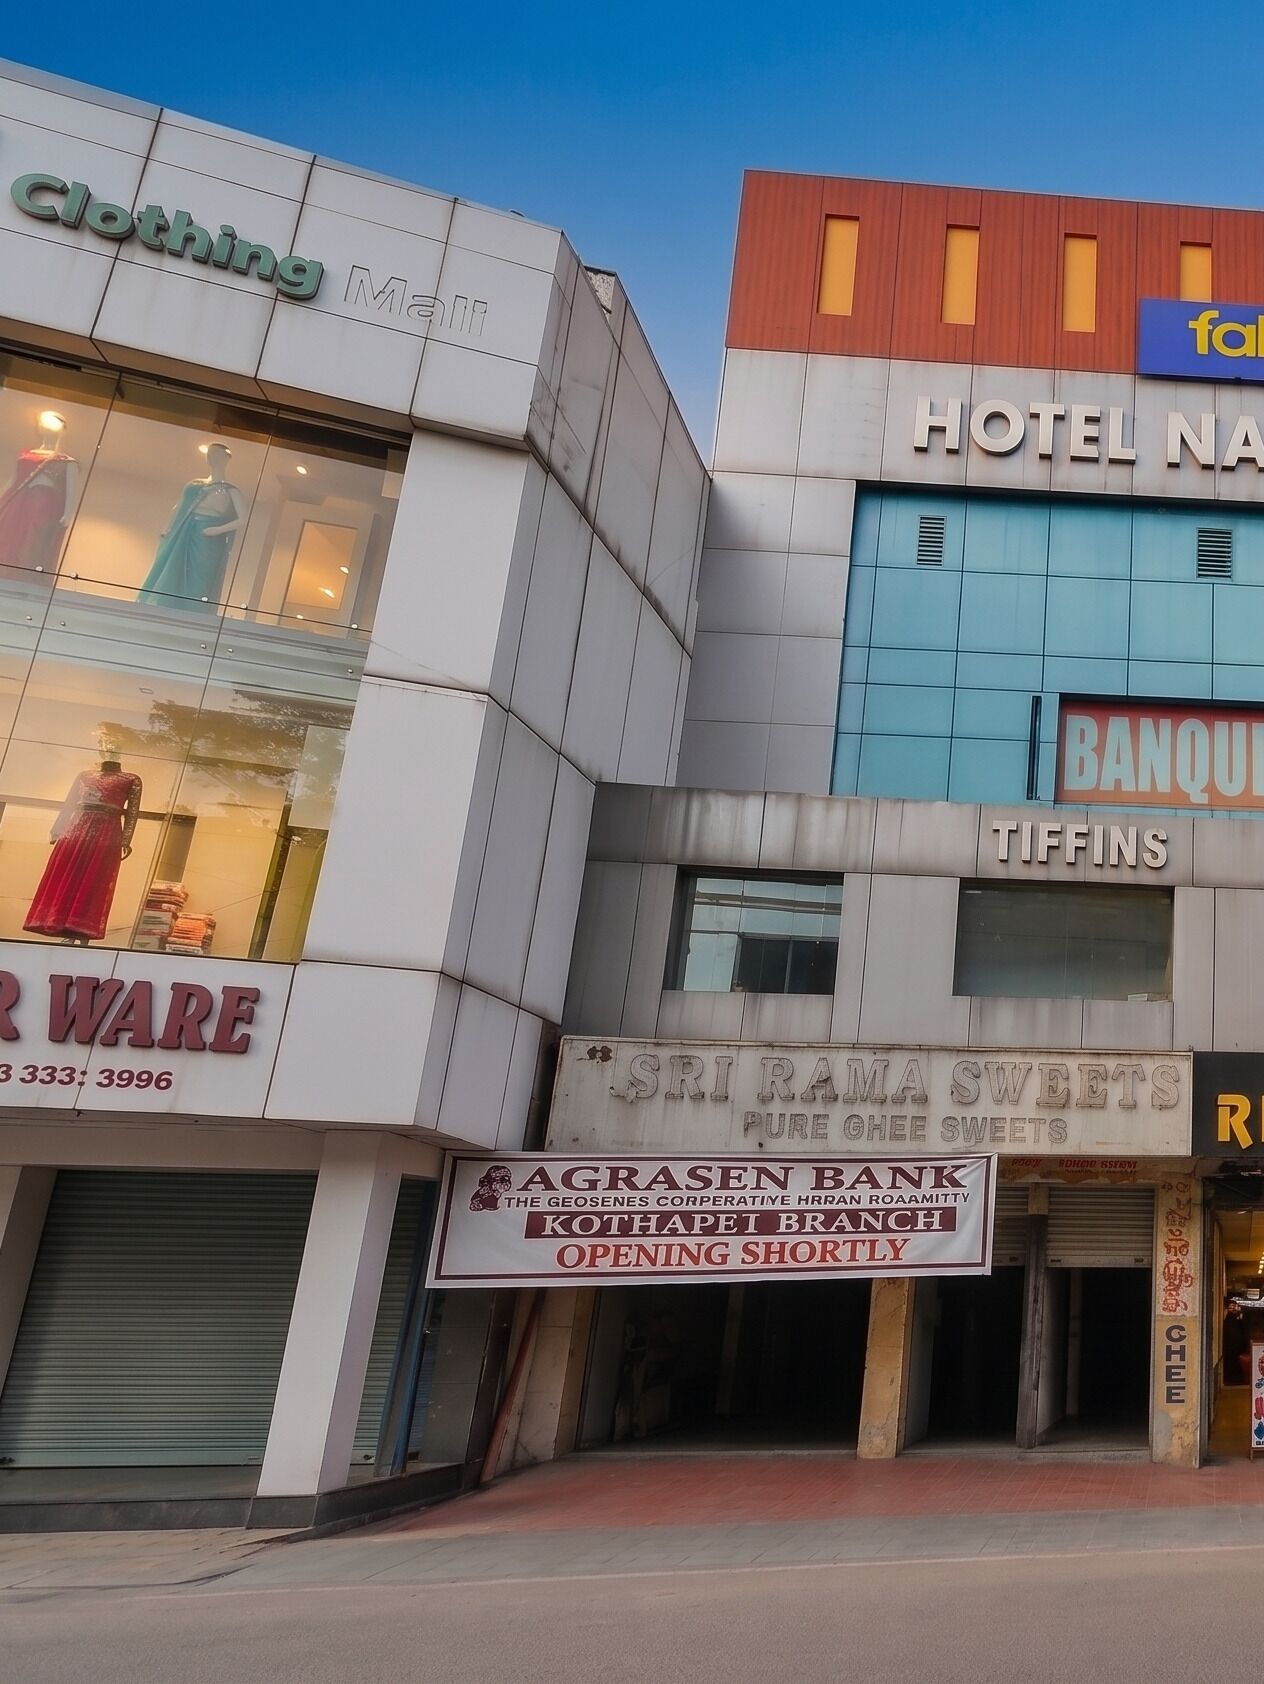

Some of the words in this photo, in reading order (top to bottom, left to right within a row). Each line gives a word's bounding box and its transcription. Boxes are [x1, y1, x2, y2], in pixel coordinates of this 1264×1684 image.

[10, 173, 325, 300] Clothing
[343, 264, 489, 337] Mall
[913, 396, 1136, 464] HOTEL
[992, 820, 1167, 868] TIFFINS
[95, 1068, 174, 1091] 3996
[628, 1053, 735, 1102] SRI
[757, 1055, 928, 1104] RAMA
[950, 1060, 1181, 1109] SWEETS
[743, 1111, 830, 1141] PURE
[843, 1114, 927, 1143] GHEE
[940, 1115, 1068, 1145] SWEETS
[516, 1166, 794, 1192] AGRASEN
[809, 1163, 969, 1191] BANK
[503, 1195, 542, 1209] THE
[546, 1195, 649, 1208] GEOSENES
[775, 1206, 944, 1232] BRANCH
[555, 1241, 730, 1270] OPENING
[740, 1237, 911, 1266] SHORTLY
